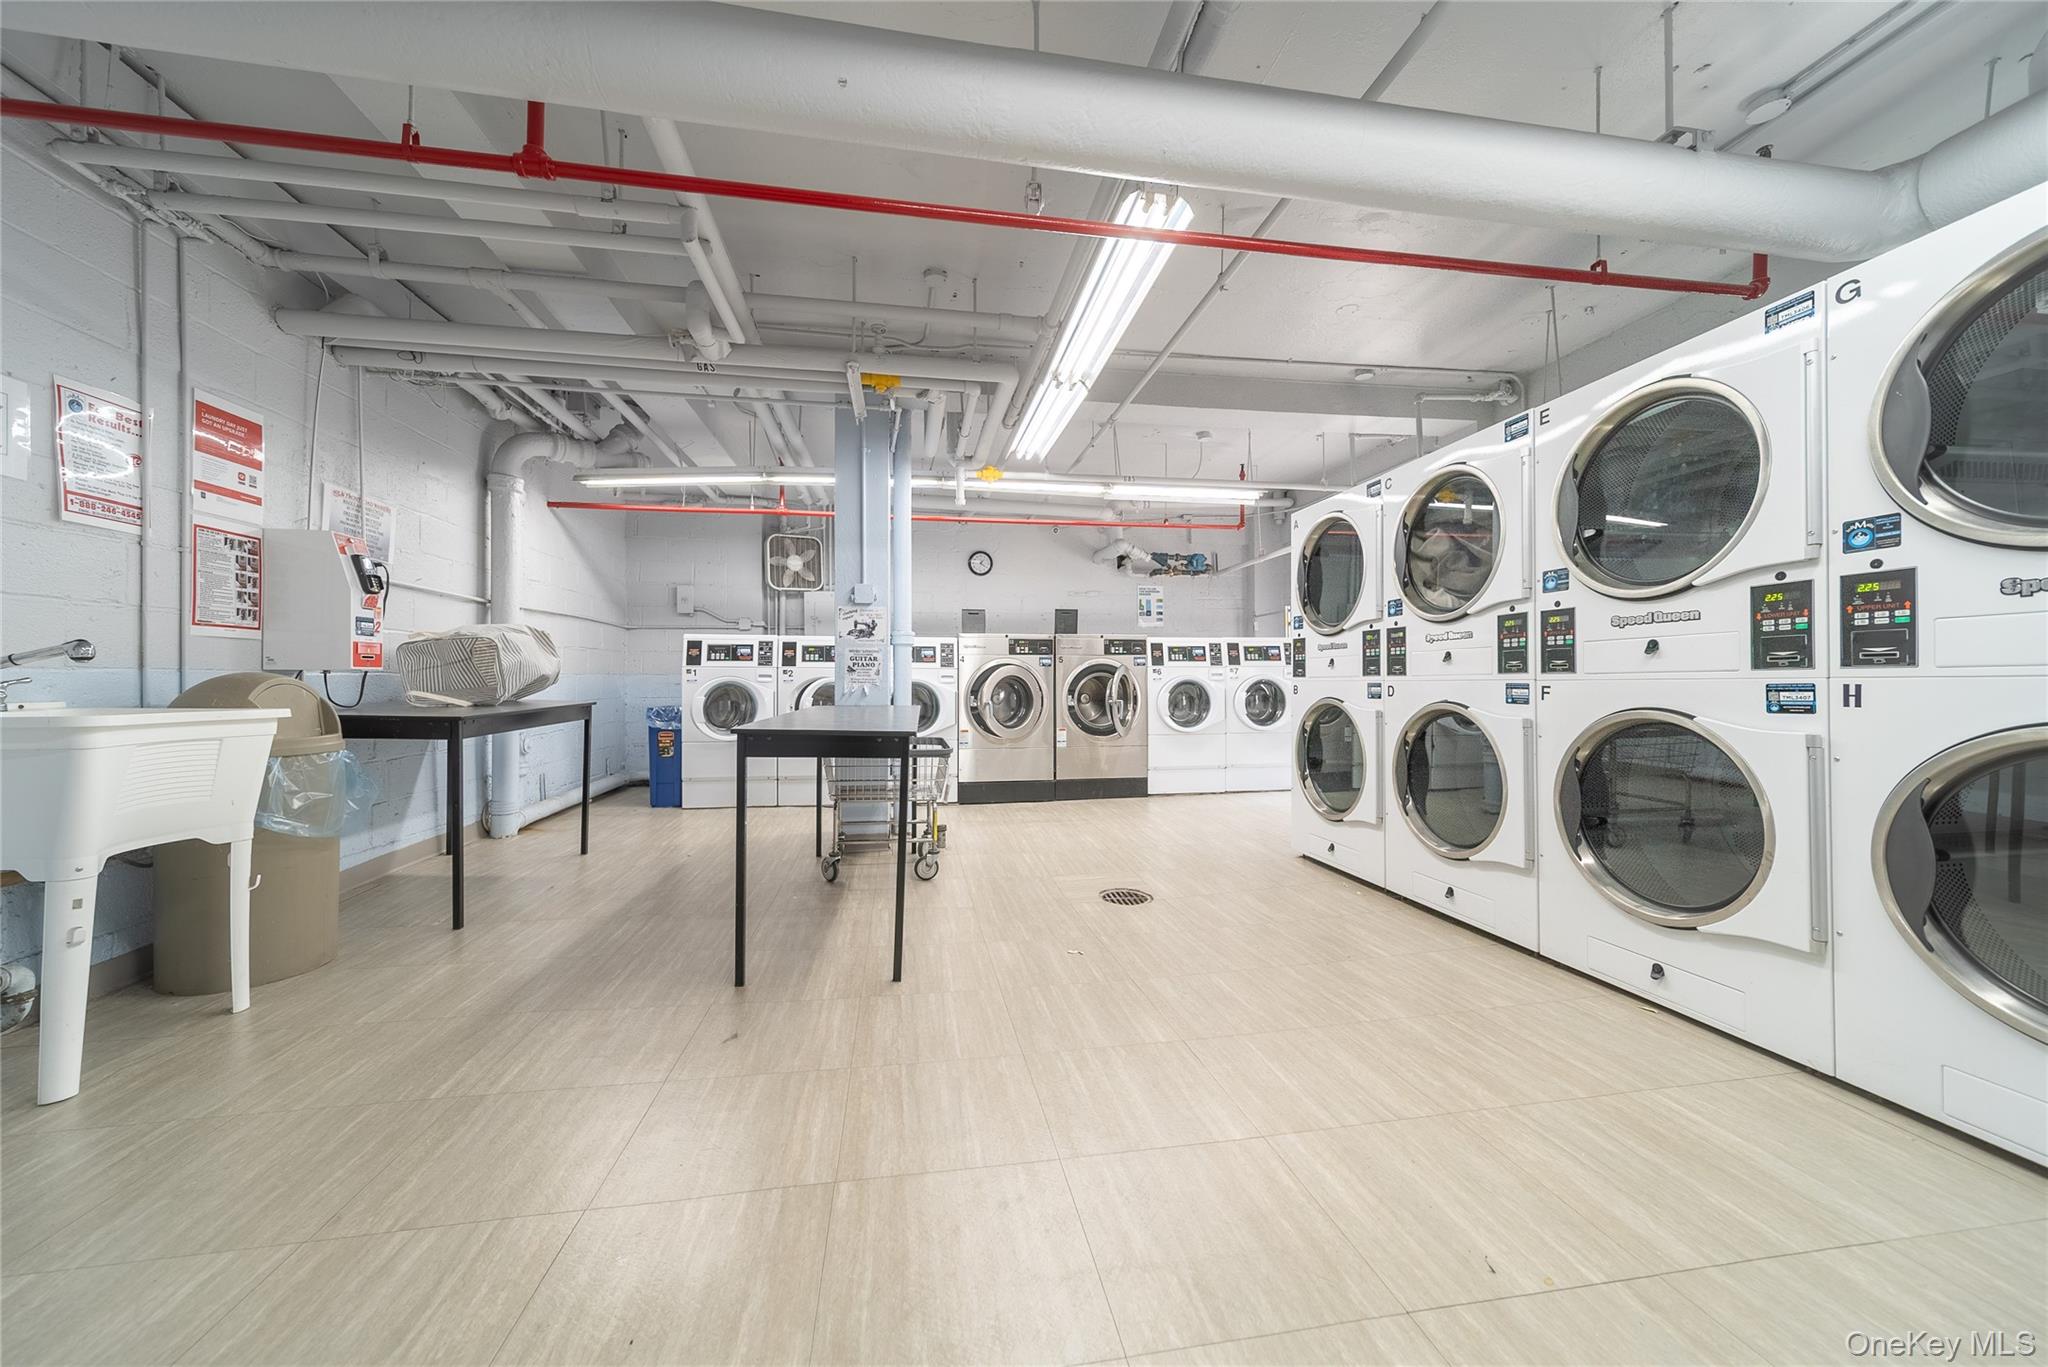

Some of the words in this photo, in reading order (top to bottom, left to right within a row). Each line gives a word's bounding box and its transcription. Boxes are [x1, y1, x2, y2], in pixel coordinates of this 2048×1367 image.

[1835, 279, 1861, 304] G
[696, 362, 715, 372] GAS
[1540, 408, 1550, 426] E
[1385, 477, 1392, 490] C
[1610, 612, 1653, 628] Speed
[1653, 610, 1701, 623] Queen
[1387, 685, 1395, 697] D
[1541, 686, 1551, 701] F
[1843, 684, 1862, 708] H
